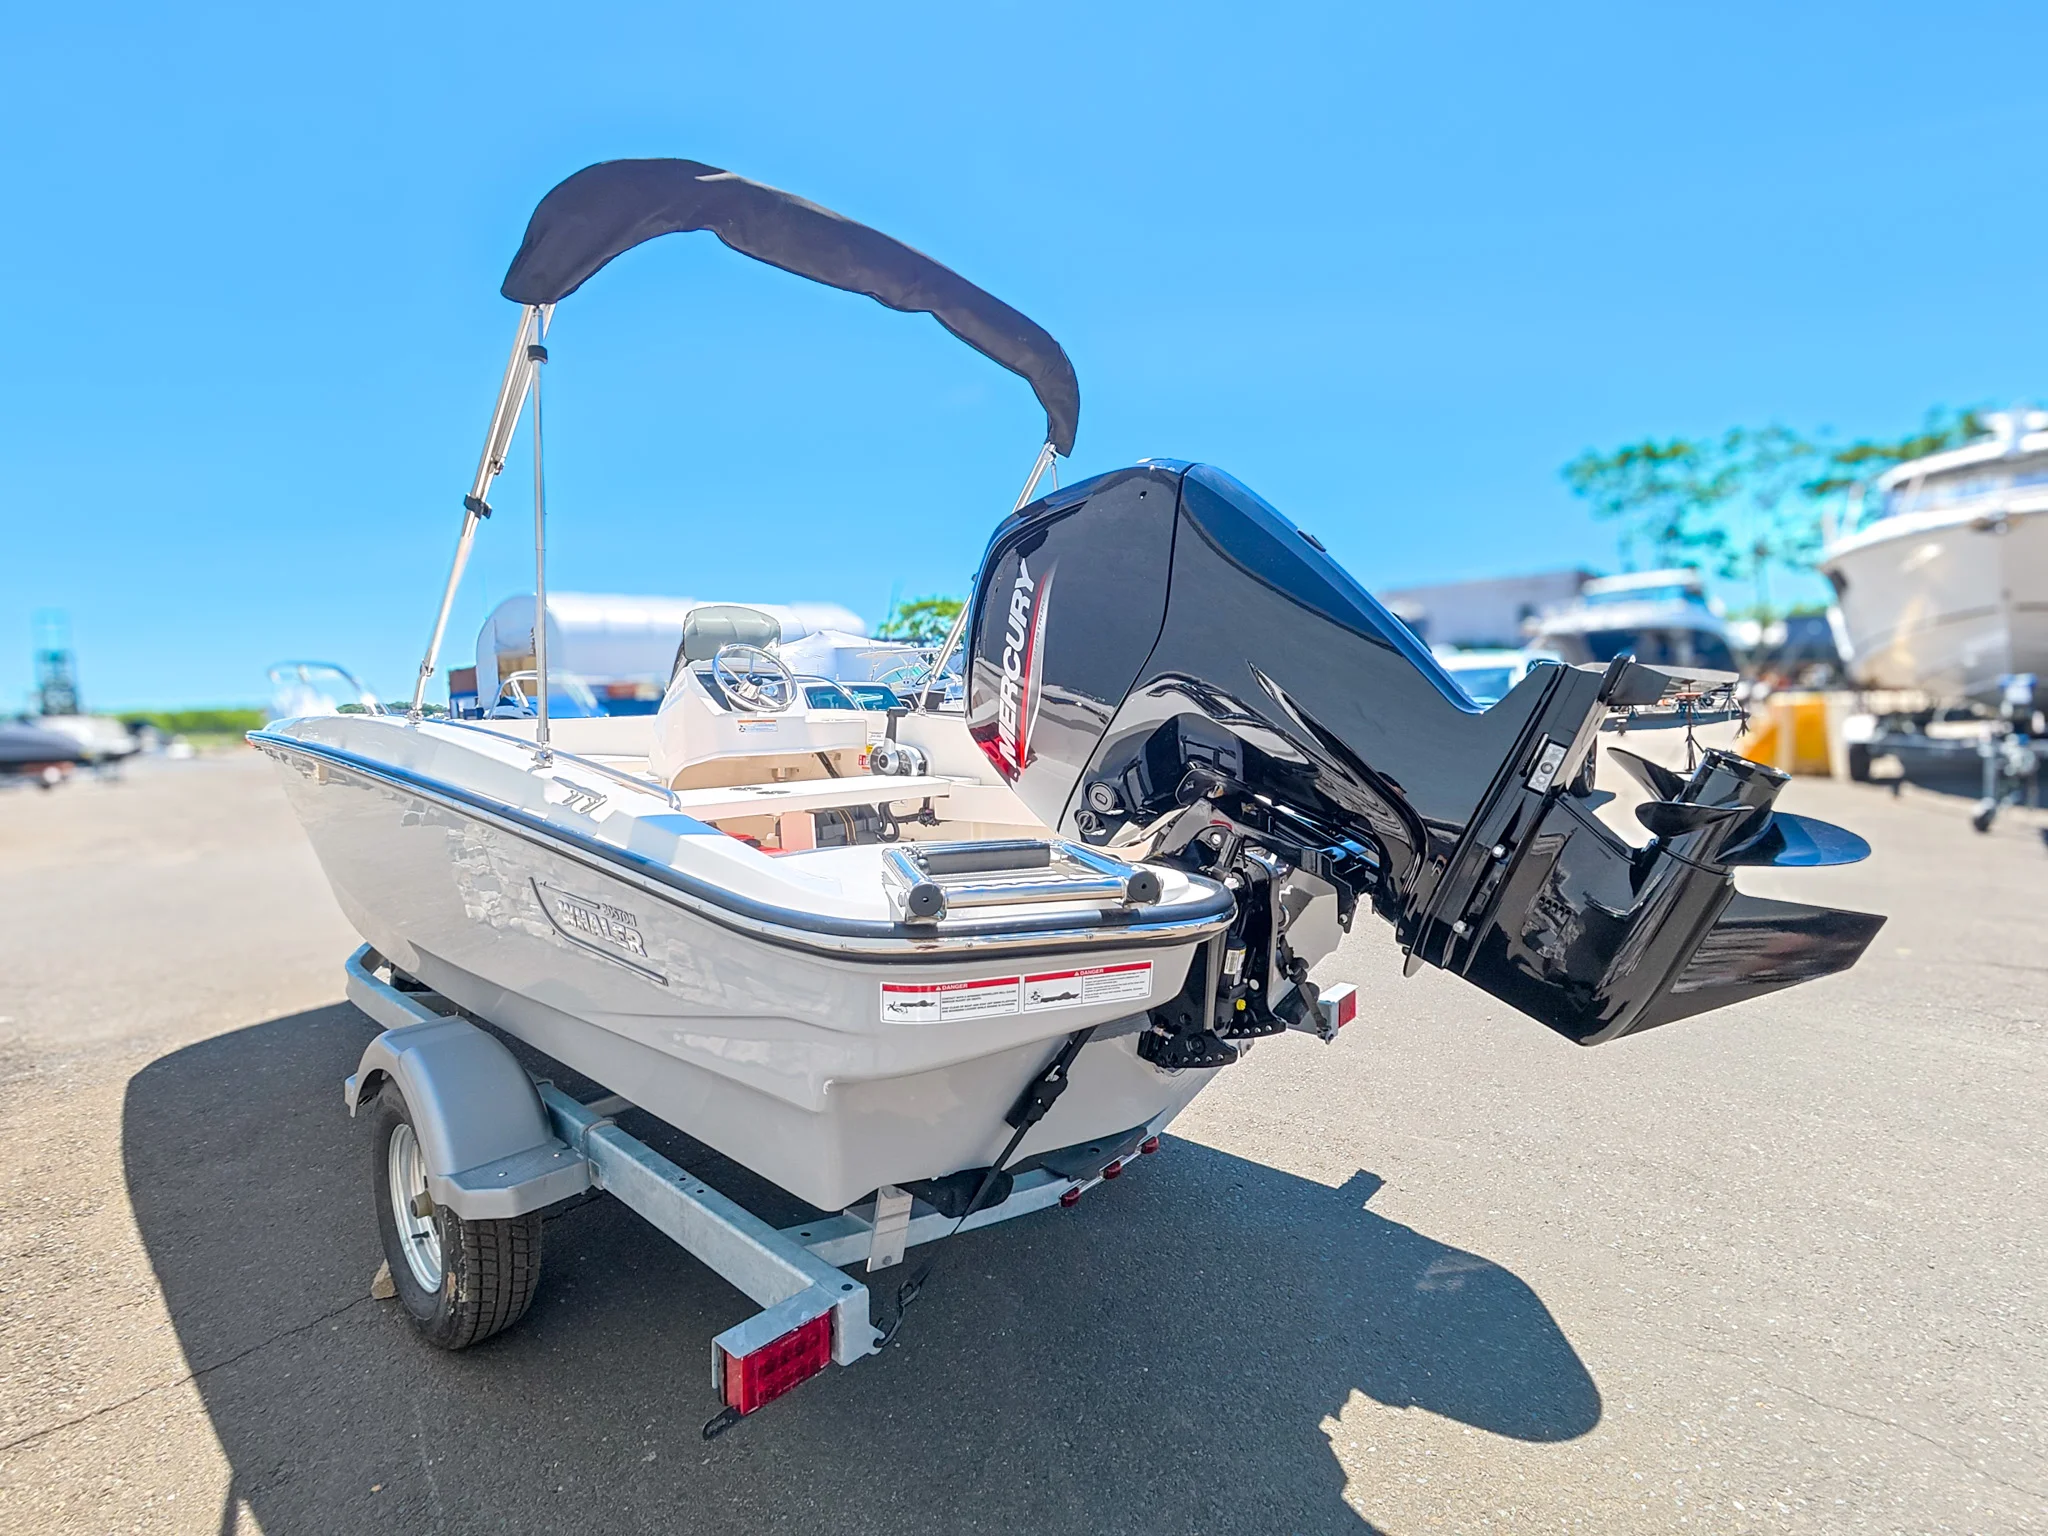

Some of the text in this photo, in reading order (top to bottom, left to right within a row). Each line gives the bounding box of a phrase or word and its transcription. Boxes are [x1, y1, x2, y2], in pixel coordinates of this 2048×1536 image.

[998, 558, 1034, 768] MERCURY
[602, 903, 637, 927] BOSTON
[557, 900, 648, 957] WHALER
[1079, 968, 1104, 976] DANGER
[941, 983, 968, 991] DANGER
